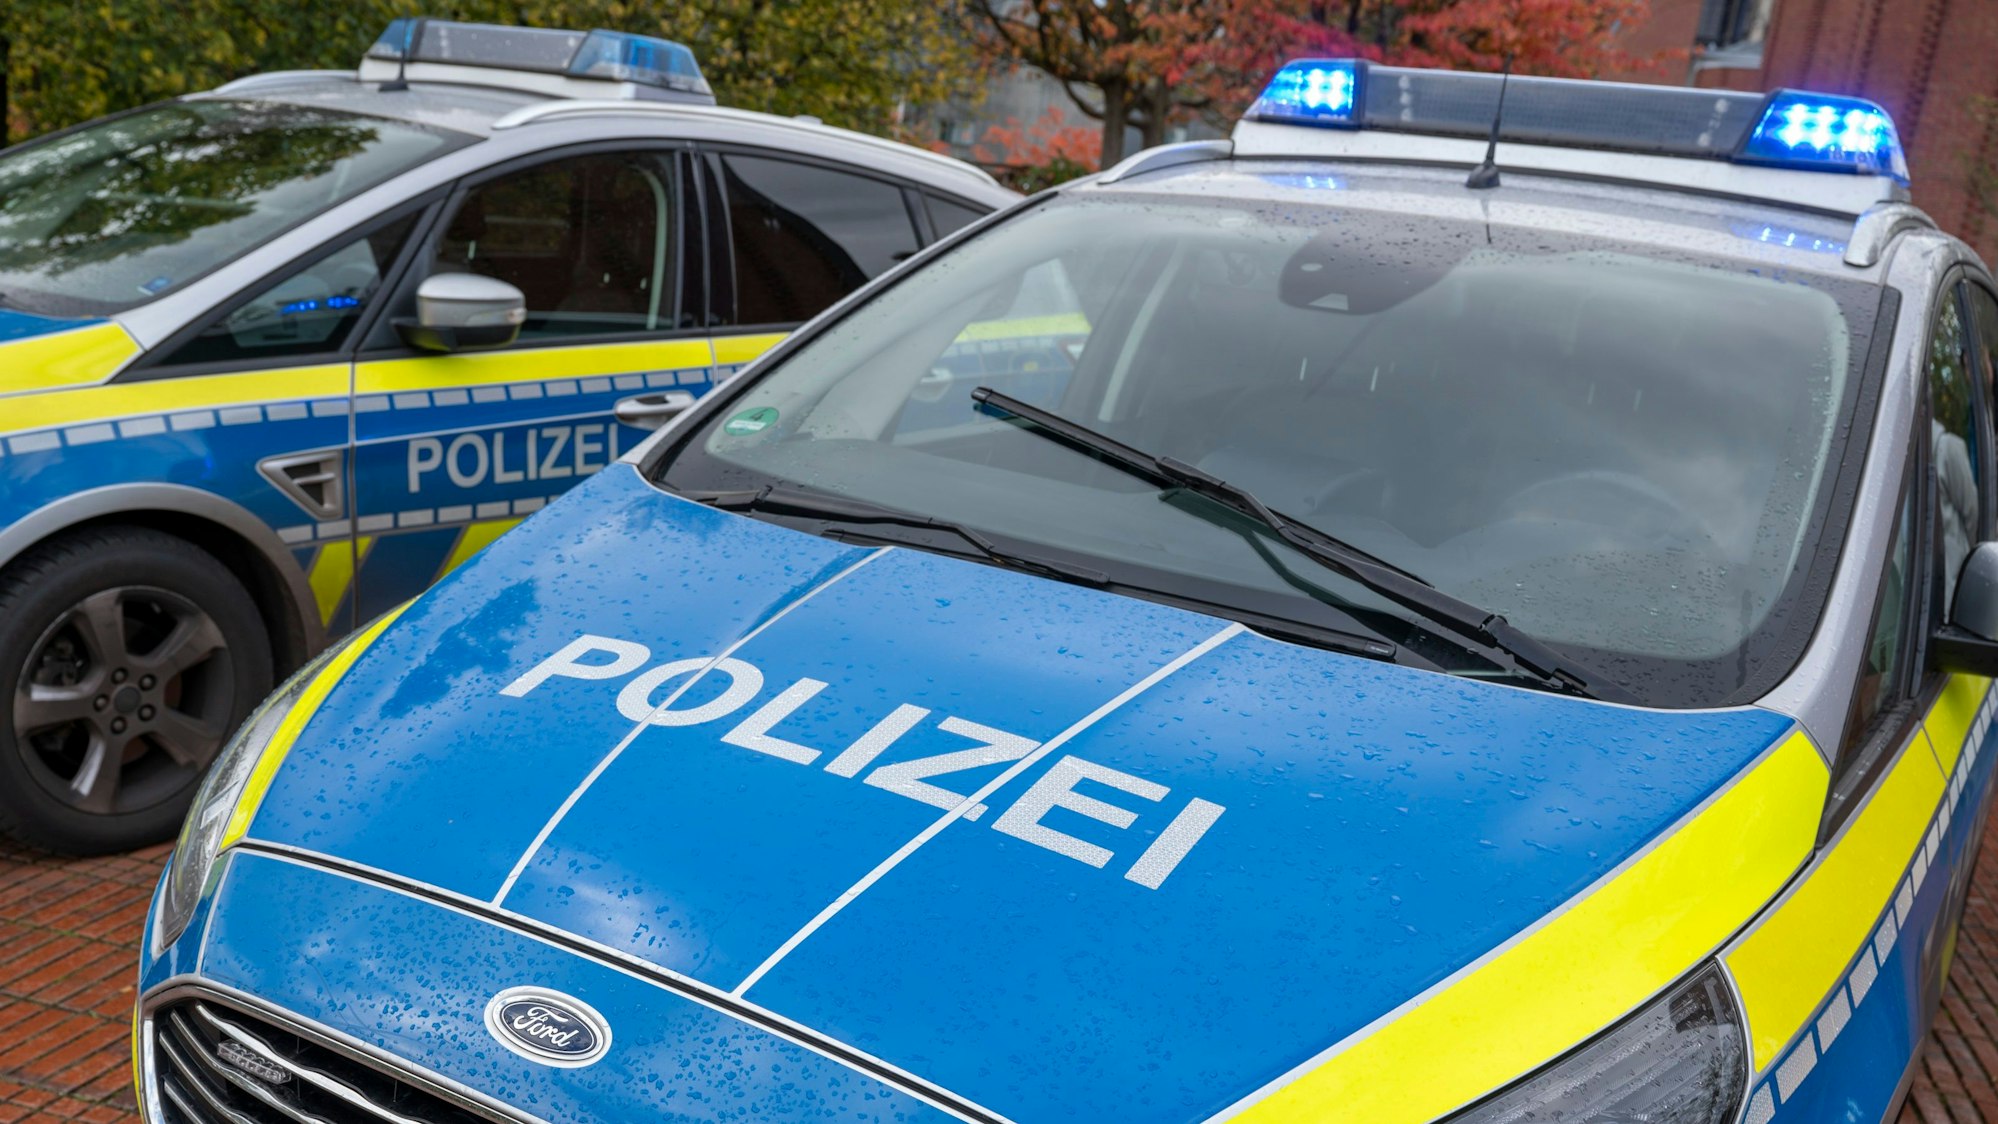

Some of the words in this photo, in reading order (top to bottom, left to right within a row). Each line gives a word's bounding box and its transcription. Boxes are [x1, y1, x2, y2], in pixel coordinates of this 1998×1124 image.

[407, 422, 619, 494] POLIZEI
[499, 633, 1226, 891] POLIZEI
[513, 1006, 580, 1047] Ford
